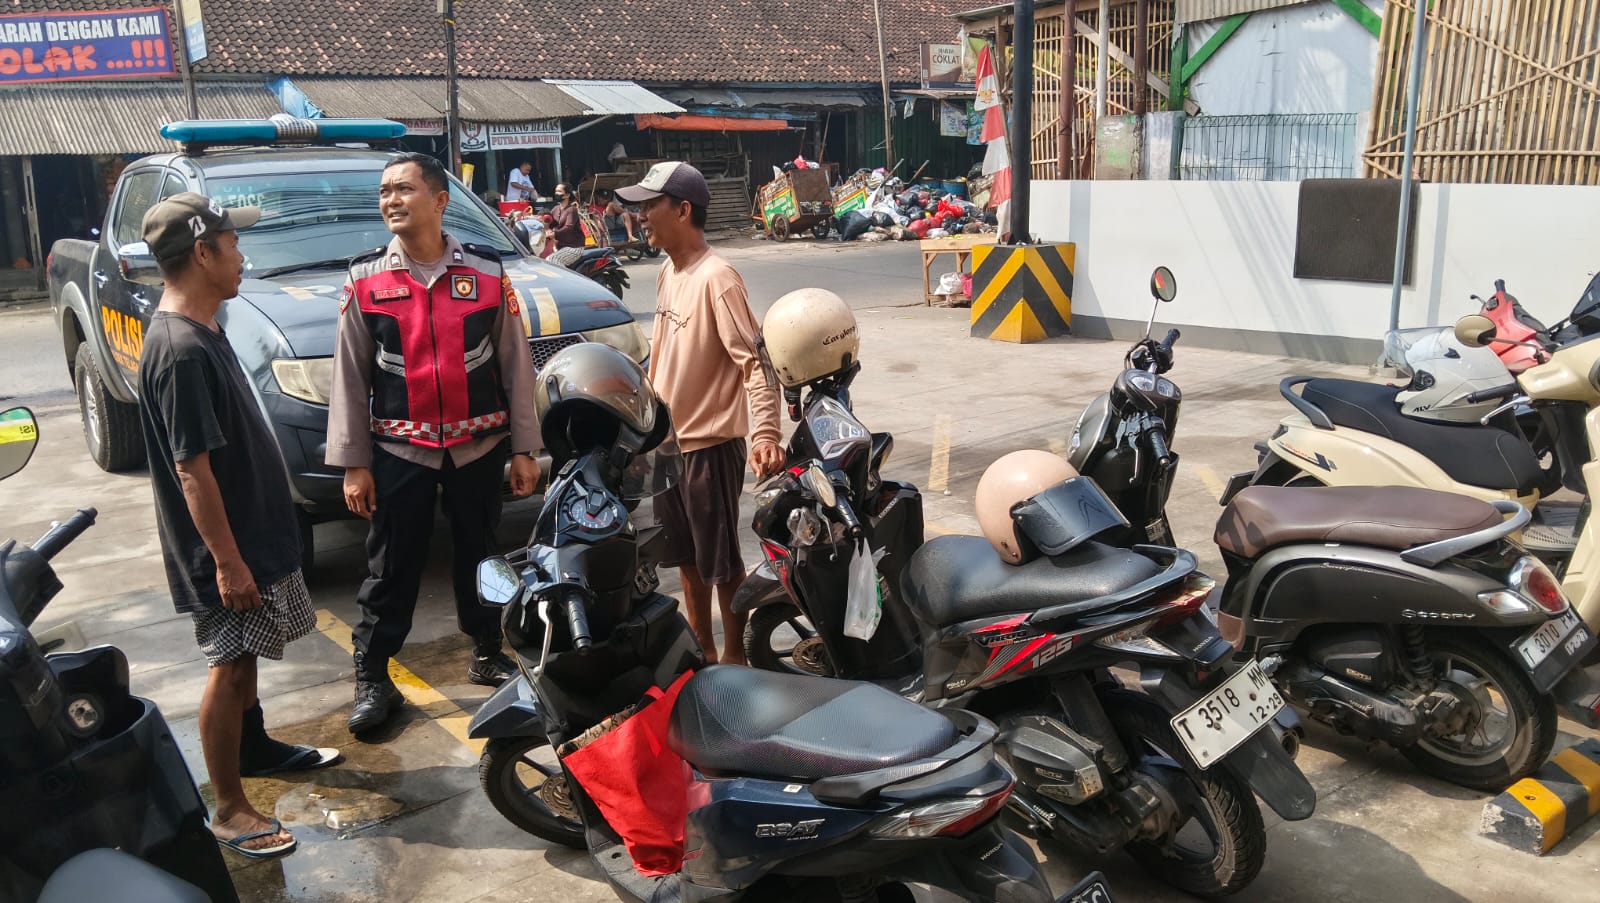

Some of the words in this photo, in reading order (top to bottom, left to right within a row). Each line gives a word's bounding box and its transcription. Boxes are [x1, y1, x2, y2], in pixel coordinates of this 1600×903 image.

[45, 19, 115, 42] DENGAN
[116, 15, 161, 37] KAMI
[932, 55, 960, 64] COKLAT
[1031, 637, 1073, 669] 125
[1177, 717, 1195, 740] T
[1198, 687, 1241, 729] 3518
